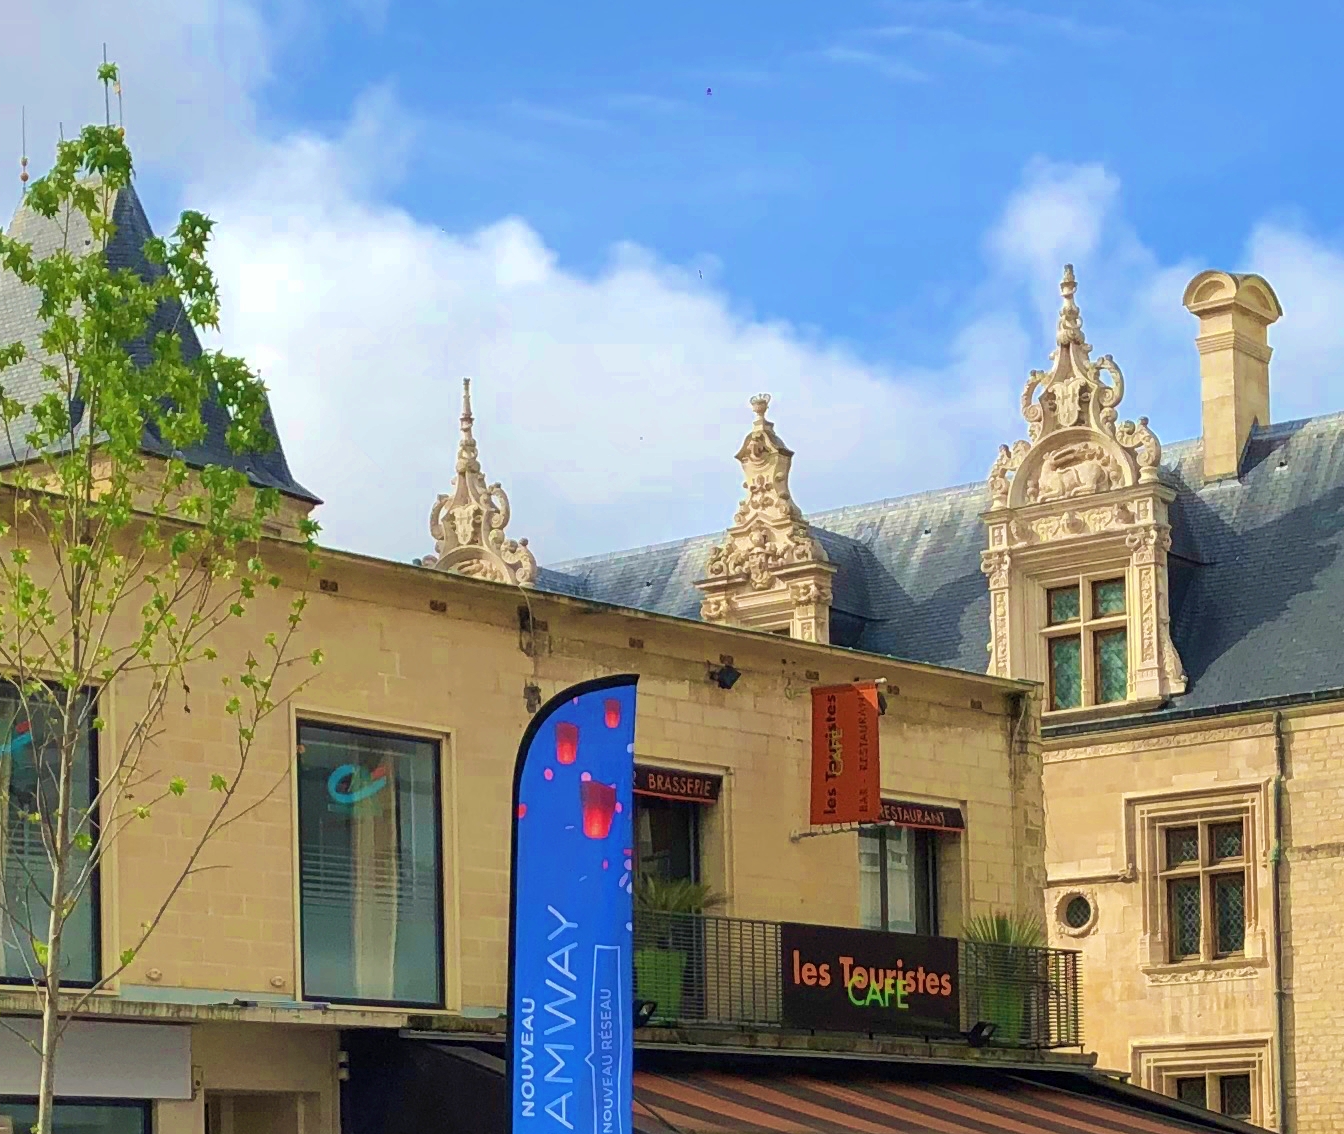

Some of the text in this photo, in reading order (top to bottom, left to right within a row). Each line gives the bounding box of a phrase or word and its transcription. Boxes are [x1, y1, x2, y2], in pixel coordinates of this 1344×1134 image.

[648, 773, 712, 796] BRASSERIE
[823, 694, 838, 815] les Touristes
[859, 788, 869, 813] BAR
[792, 949, 953, 997] les Touristes
[521, 997, 536, 1118] NOUVEAU
[601, 987, 613, 1134] NOUVEAU RÉSEAU
